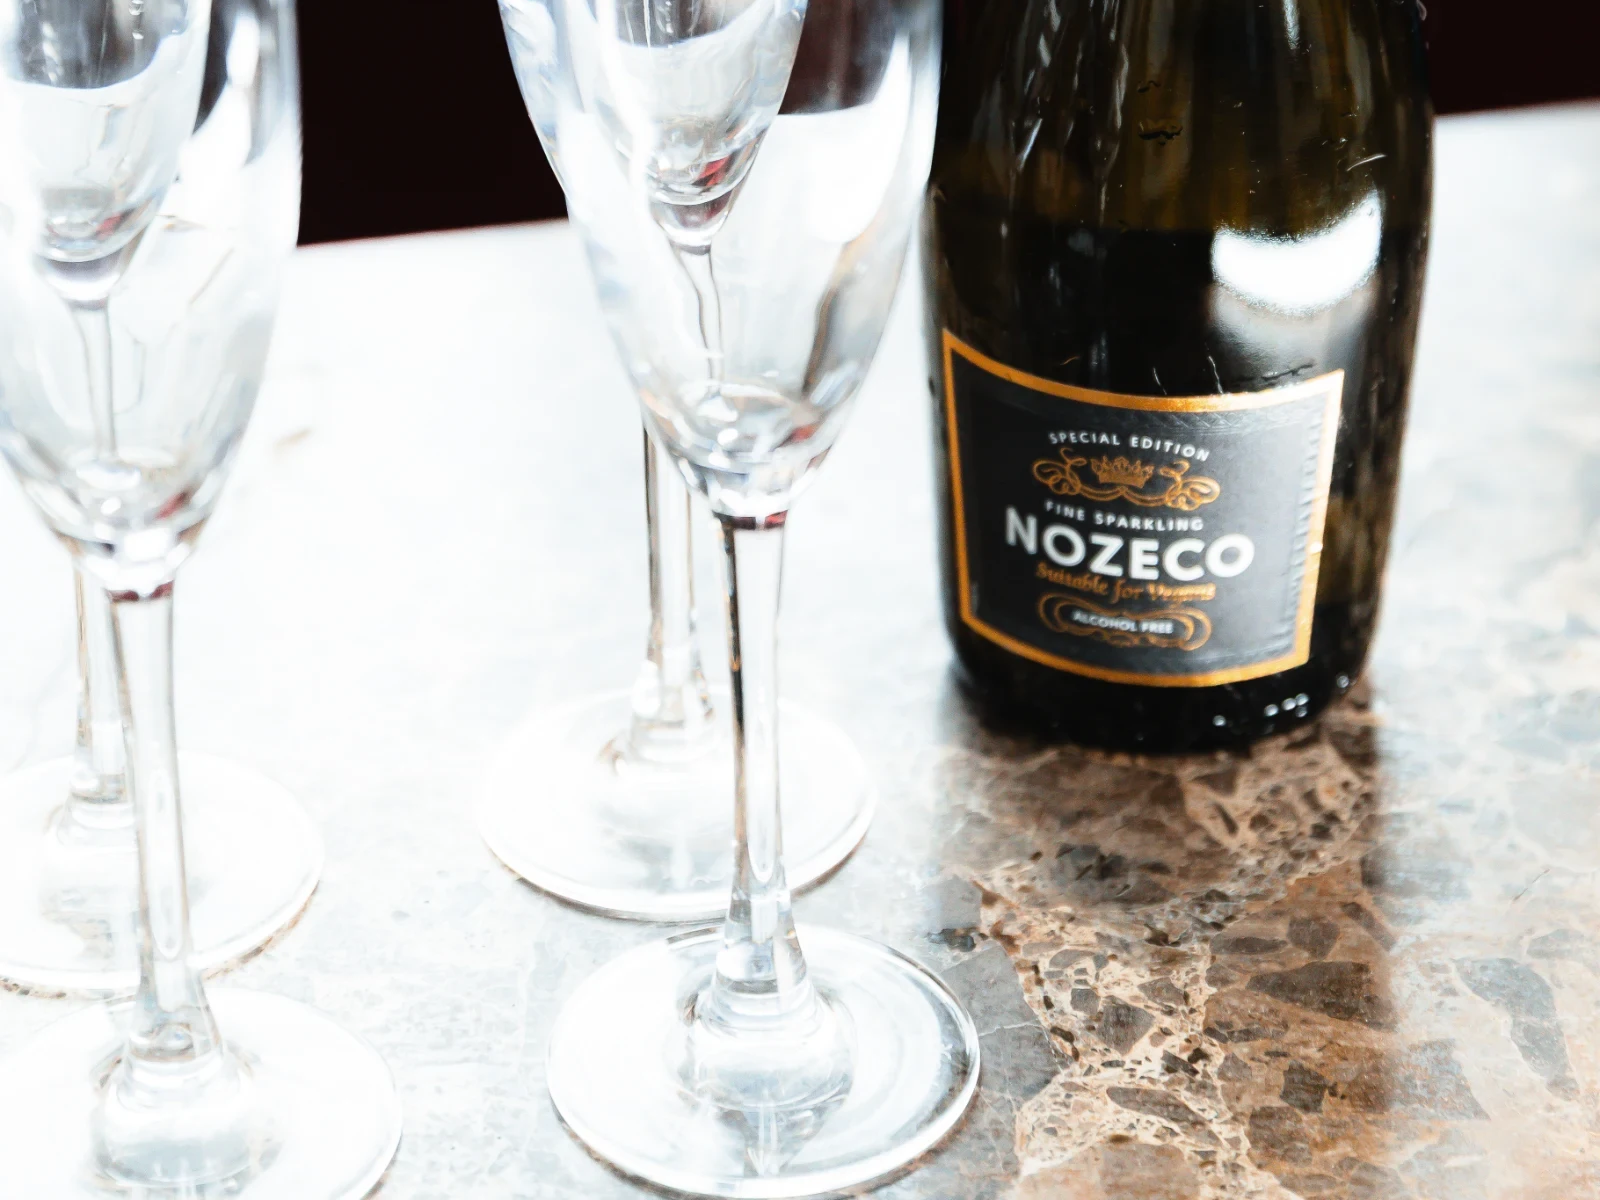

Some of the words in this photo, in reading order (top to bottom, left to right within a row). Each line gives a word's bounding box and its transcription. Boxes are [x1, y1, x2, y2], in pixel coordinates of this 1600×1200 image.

[1049, 430, 1121, 446] SPECIAL
[1129, 436, 1210, 462] EDITION
[1045, 501, 1086, 522] FINE
[1093, 512, 1204, 532] SPARKLING
[1005, 504, 1255, 582] NOZECO
[1035, 561, 1109, 597] Suitable
[1110, 579, 1144, 604] for
[1071, 609, 1138, 633] ALCOHOL
[1140, 618, 1175, 635] FREE
